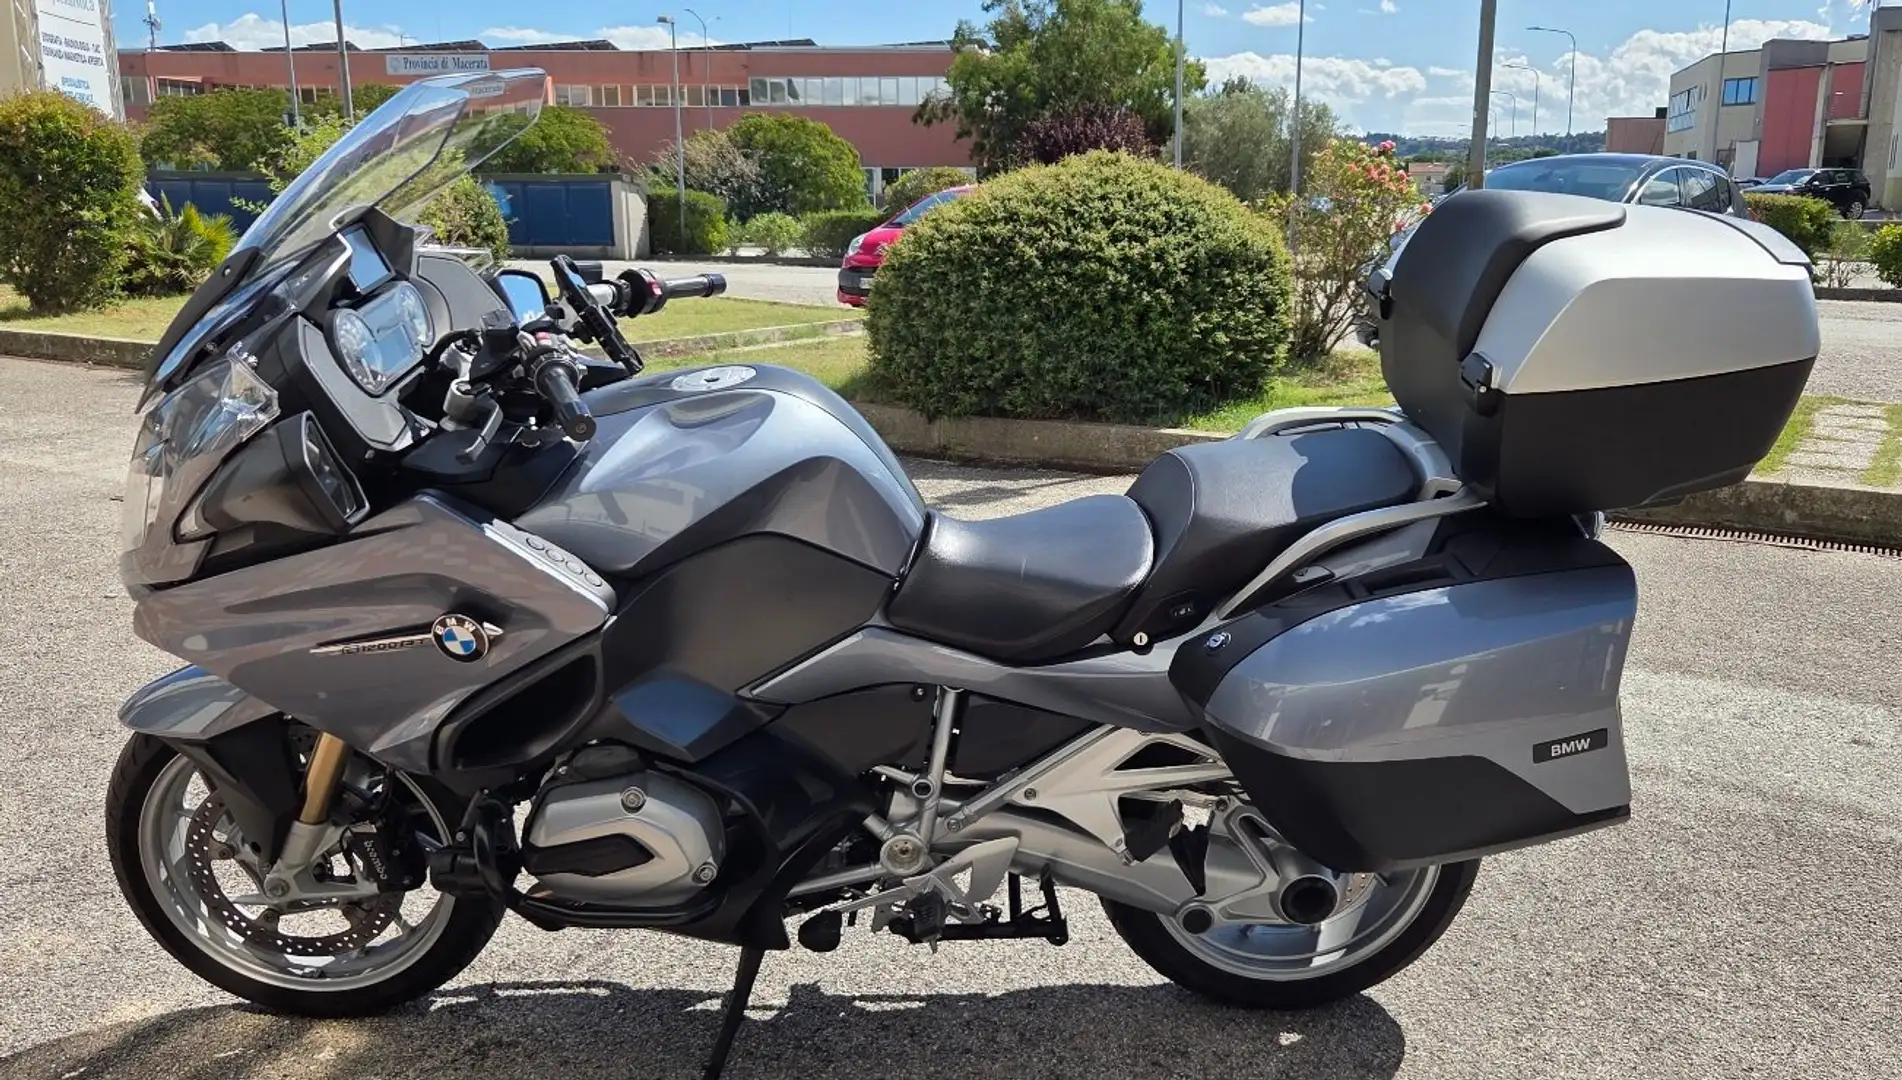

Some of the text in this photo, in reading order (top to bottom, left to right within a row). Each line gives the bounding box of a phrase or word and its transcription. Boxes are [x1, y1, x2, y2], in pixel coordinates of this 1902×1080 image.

[403, 57, 488, 69] Provincia di Macerata
[1551, 738, 1591, 757] BMW
